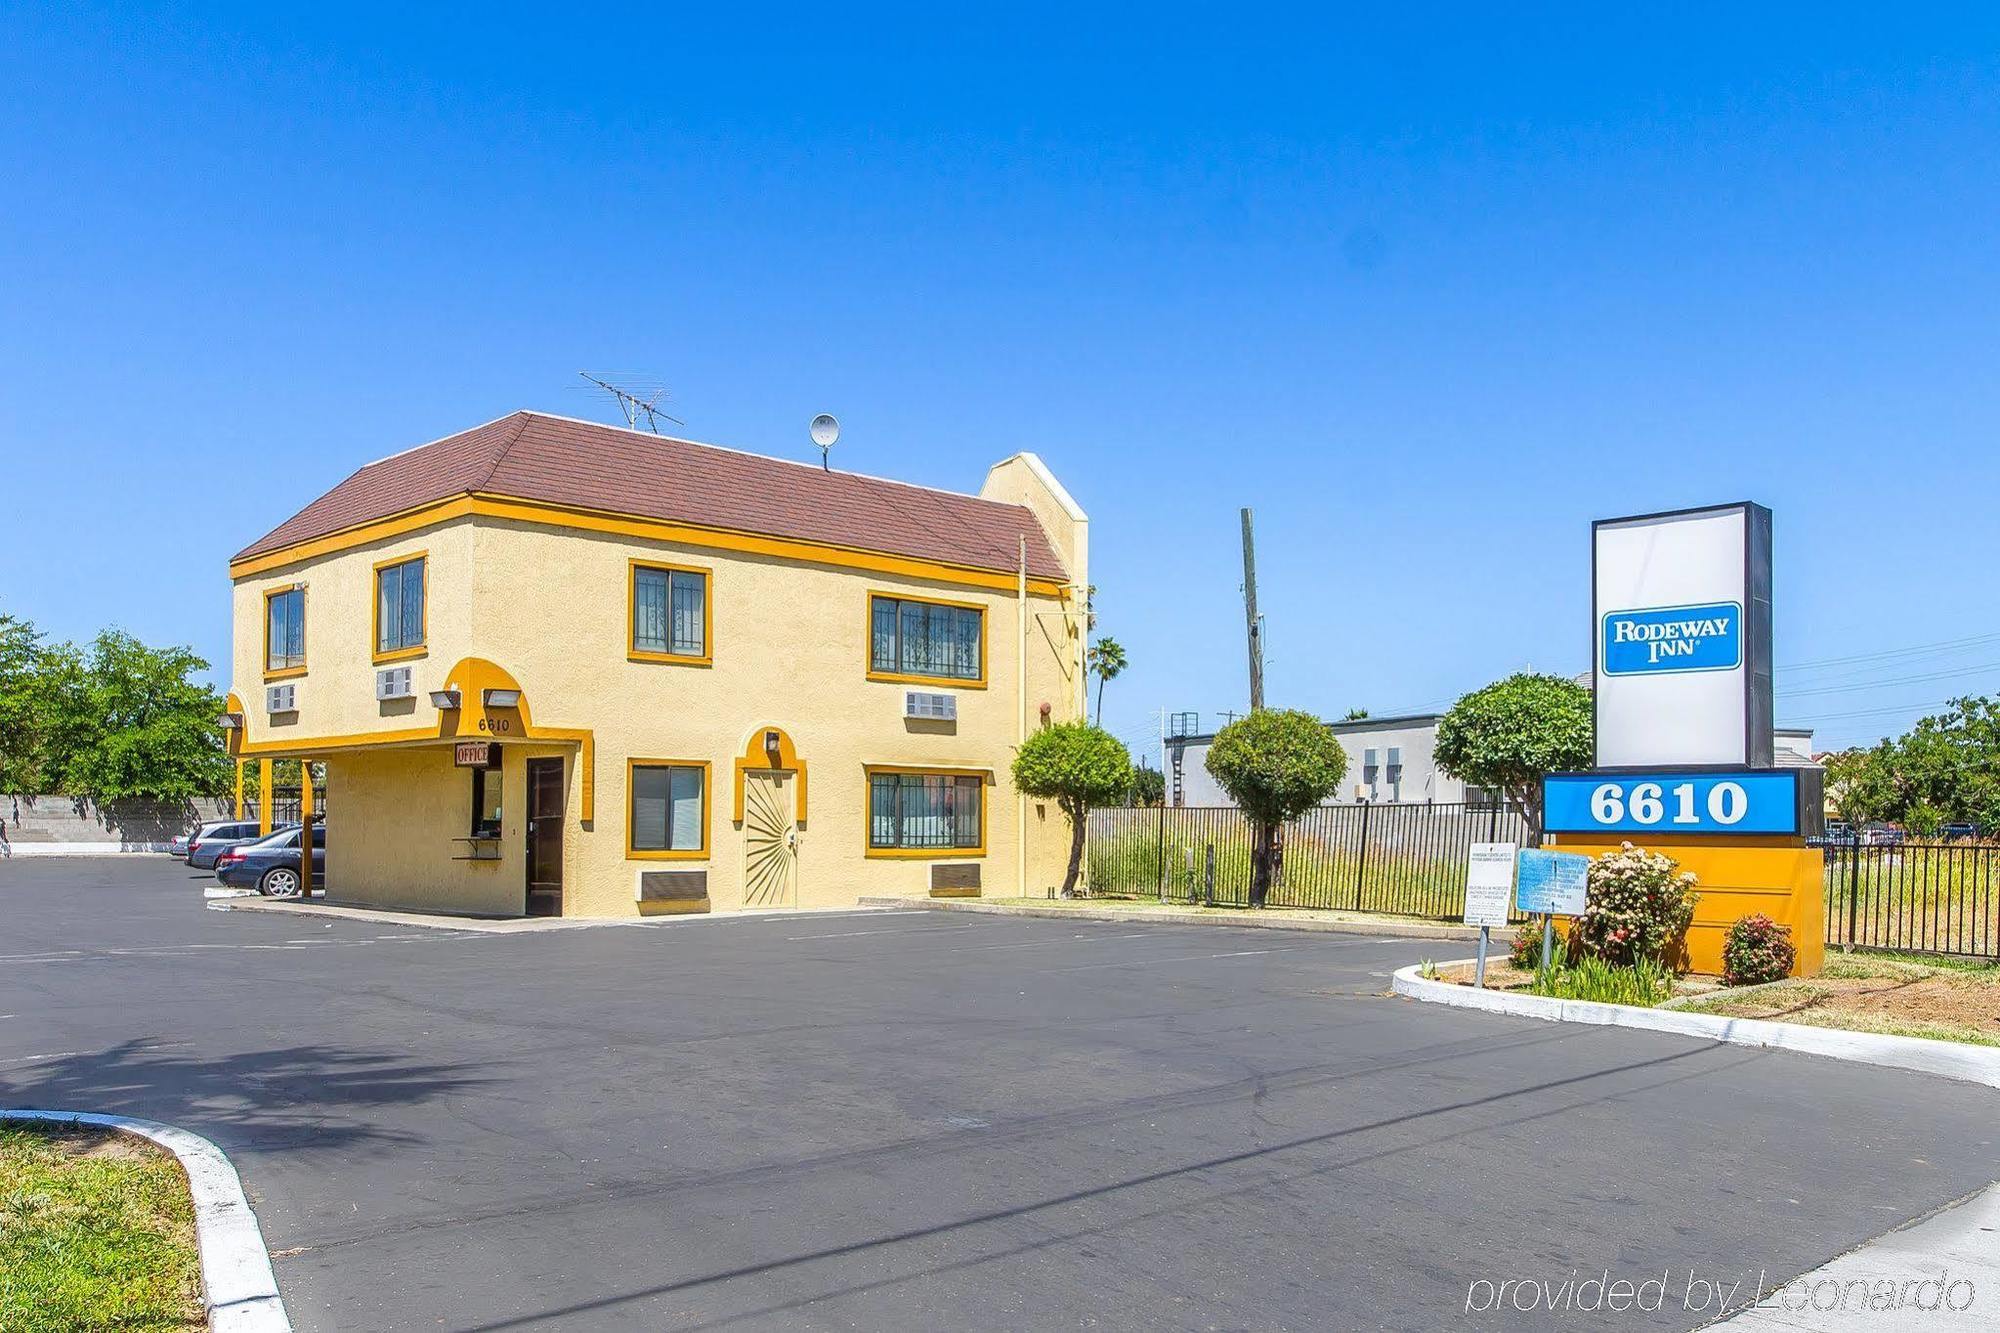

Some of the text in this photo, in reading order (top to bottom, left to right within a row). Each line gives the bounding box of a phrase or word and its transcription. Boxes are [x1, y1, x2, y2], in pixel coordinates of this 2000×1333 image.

[1613, 617, 1730, 643] RODEWAY
[479, 718, 509, 731] 6610
[458, 747, 488, 762] OFFICE
[1590, 781, 1748, 825] 6610
